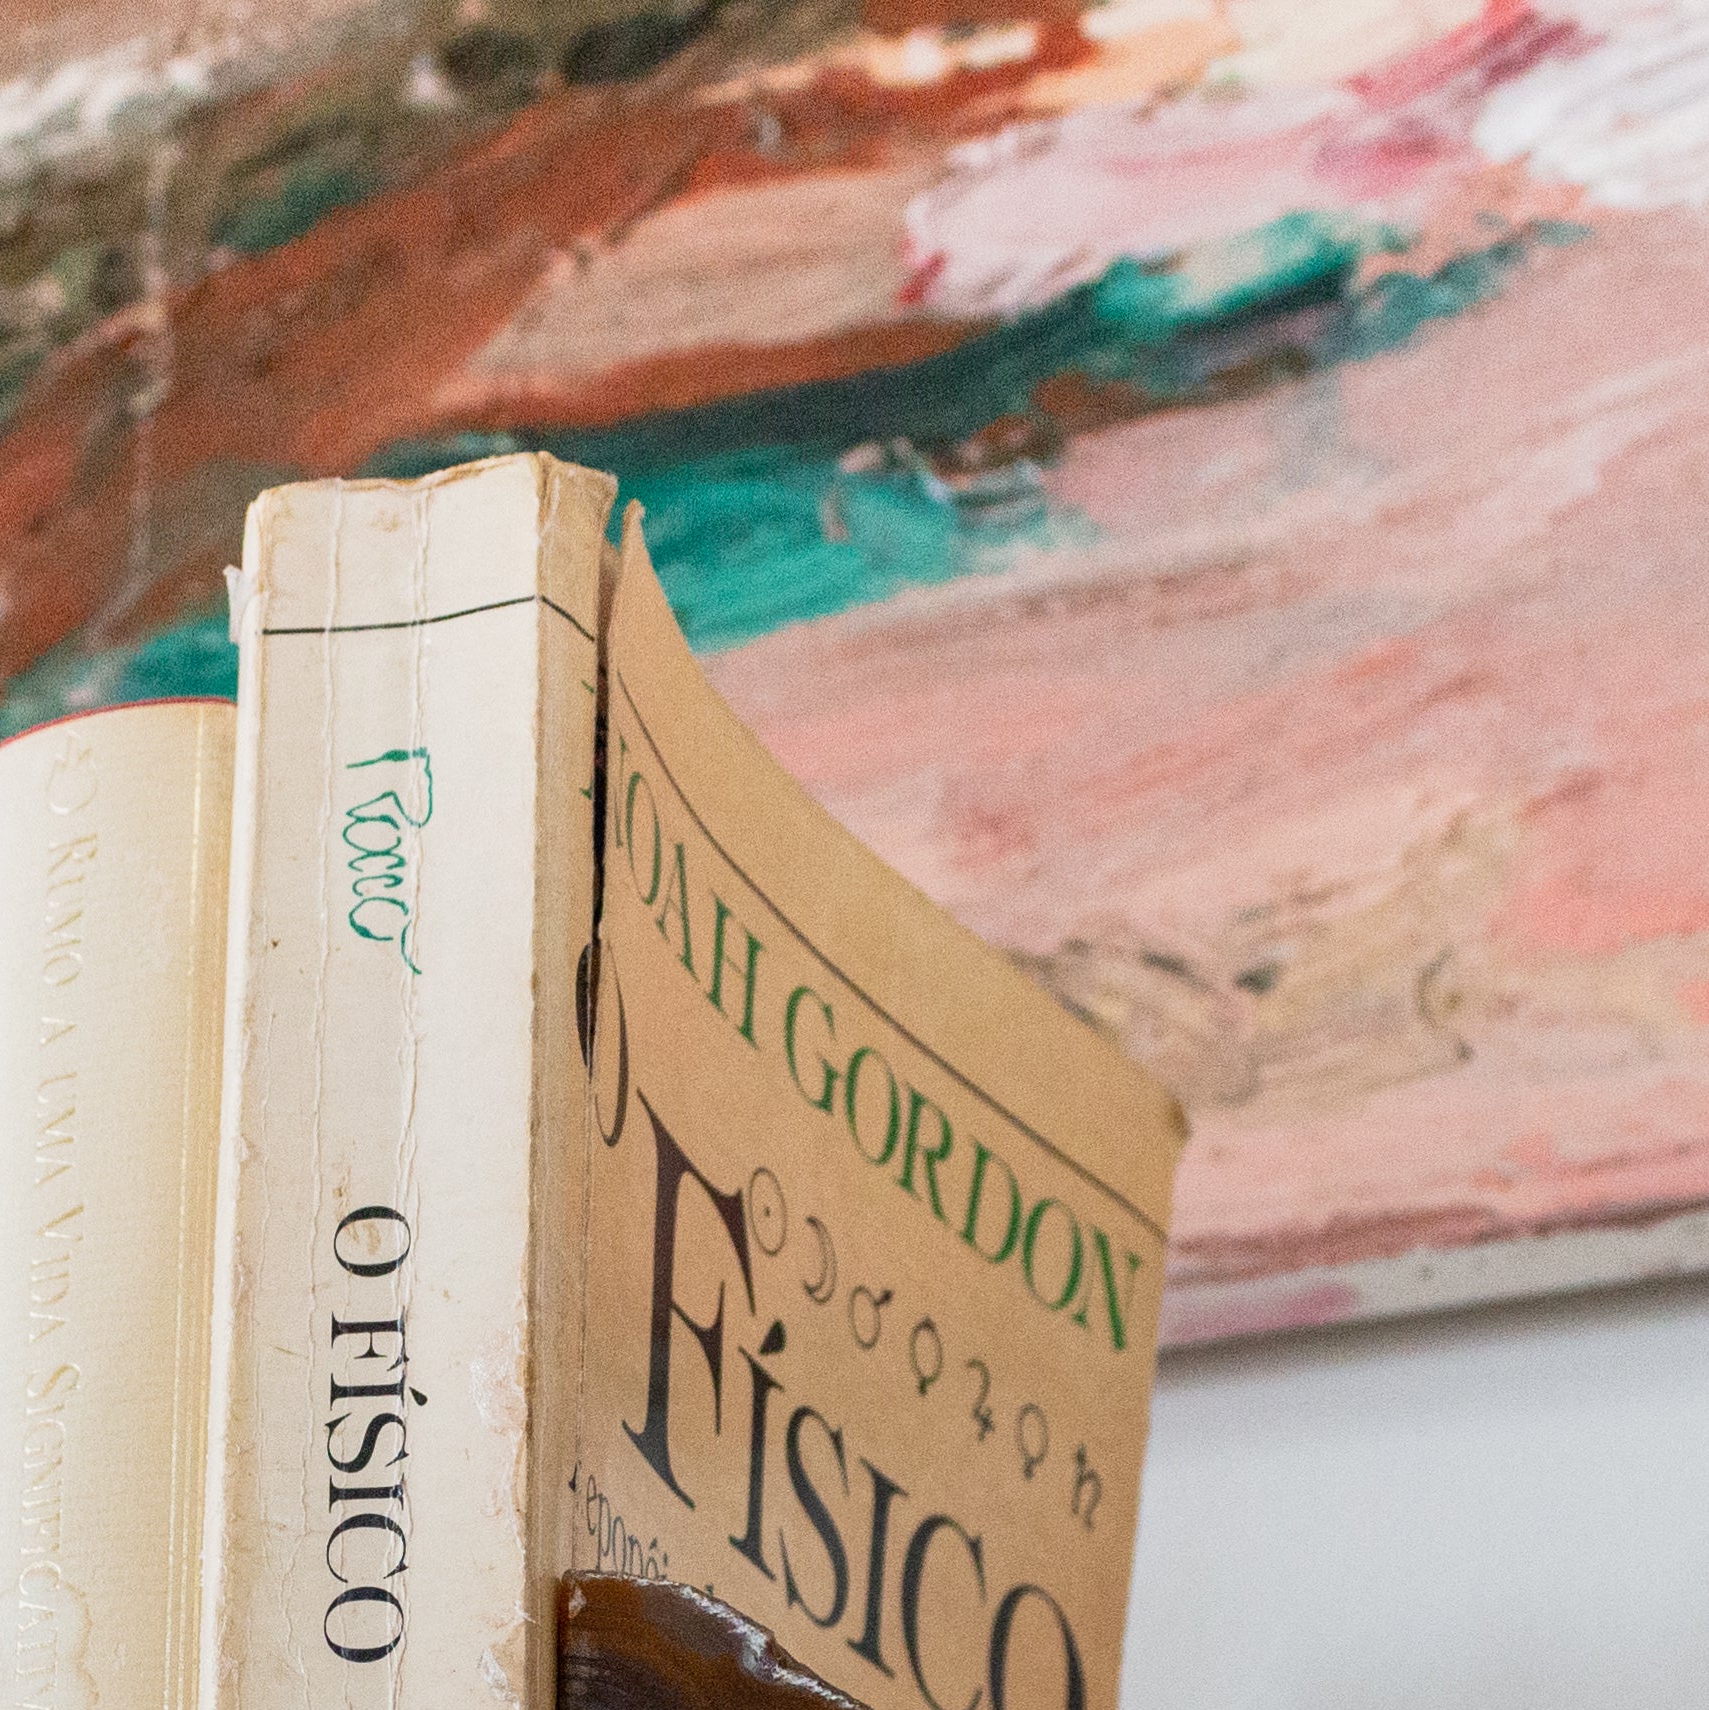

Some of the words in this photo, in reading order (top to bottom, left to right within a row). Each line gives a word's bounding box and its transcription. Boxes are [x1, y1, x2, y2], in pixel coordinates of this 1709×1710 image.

[28, 1203, 84, 1342] VIDA
[334, 1205, 411, 1278] O
[784, 986, 1143, 1350] GORDON
[323, 1314, 428, 1664] FÍSICO
